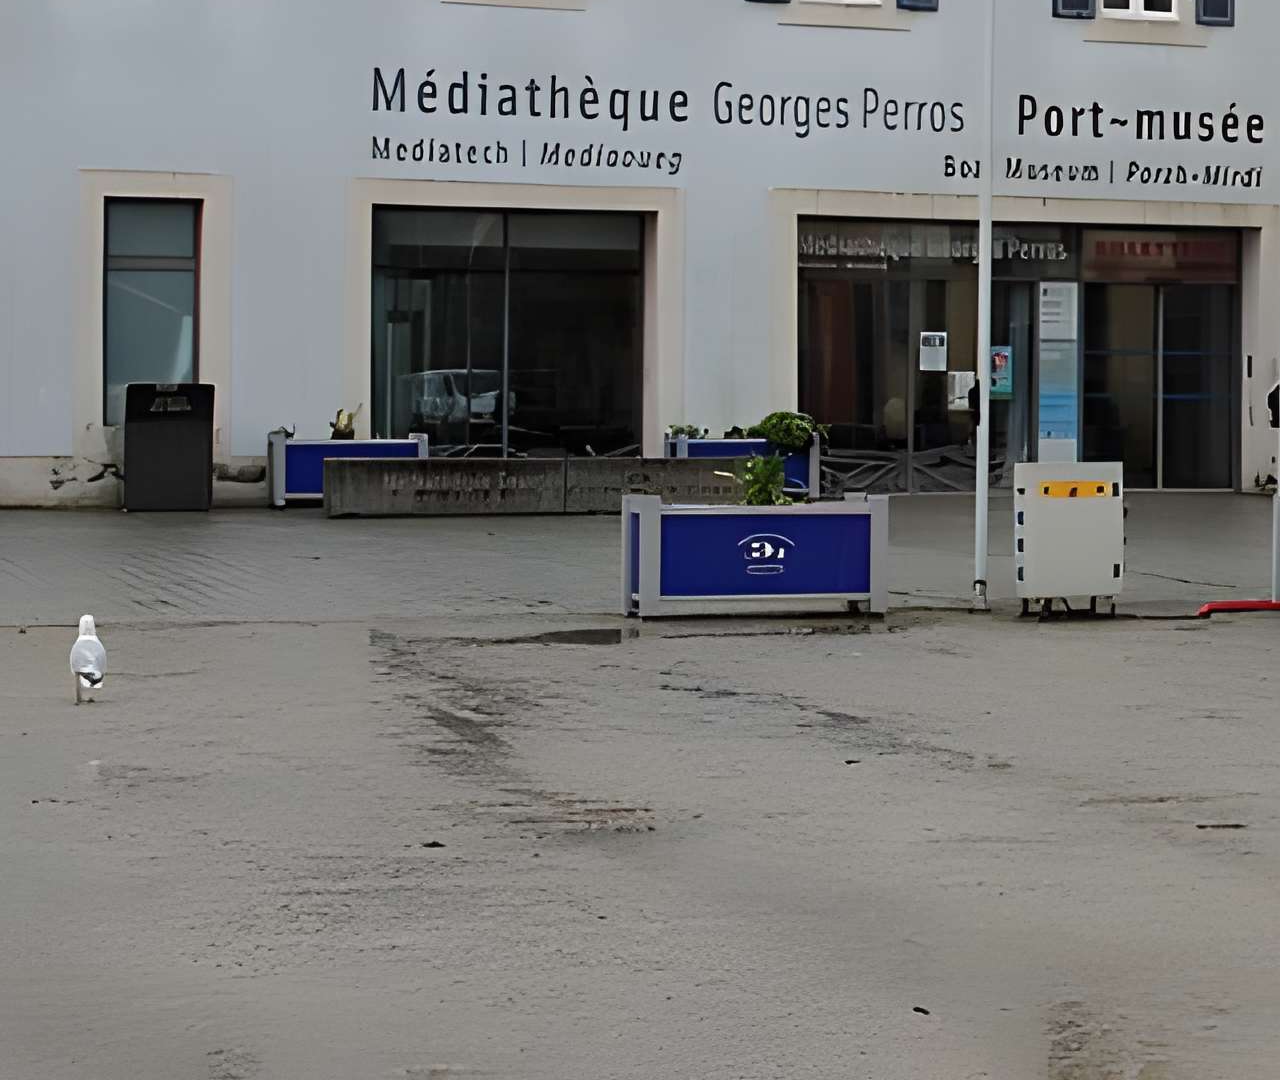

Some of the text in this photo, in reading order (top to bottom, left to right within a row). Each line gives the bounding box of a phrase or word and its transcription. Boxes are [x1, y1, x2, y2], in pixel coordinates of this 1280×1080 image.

[372, 67, 965, 138] Médiathèque Georges Perros
